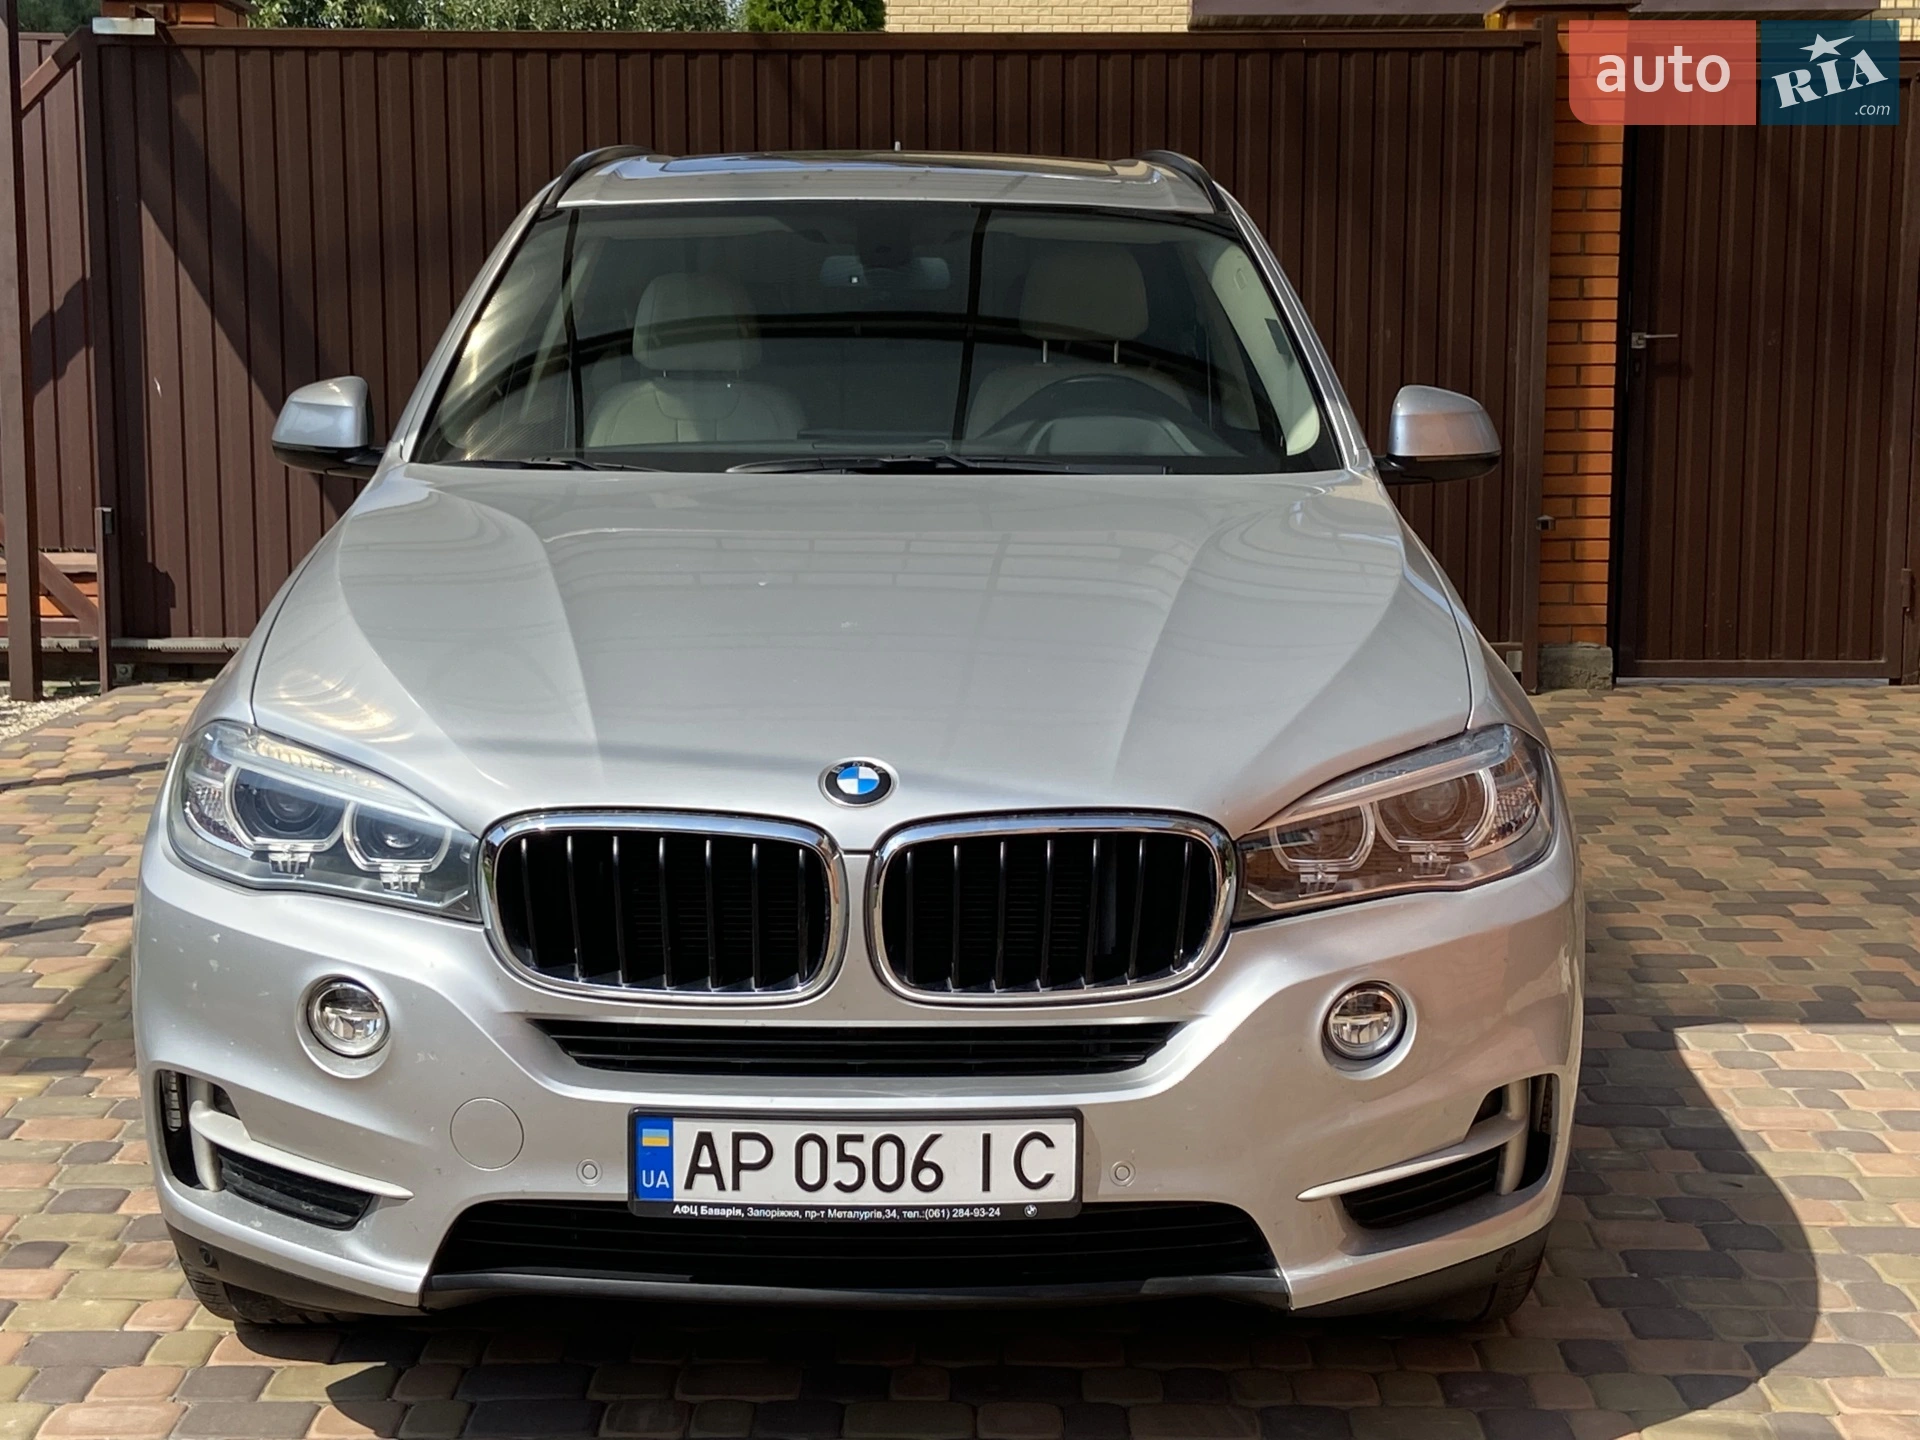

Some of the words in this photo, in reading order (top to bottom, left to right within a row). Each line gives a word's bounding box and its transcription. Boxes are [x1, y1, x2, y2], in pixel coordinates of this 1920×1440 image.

[794, 1132, 944, 1193] 0506
[641, 1169, 670, 1189] UA
[952, 1207, 1001, 1218] 284-93-24
